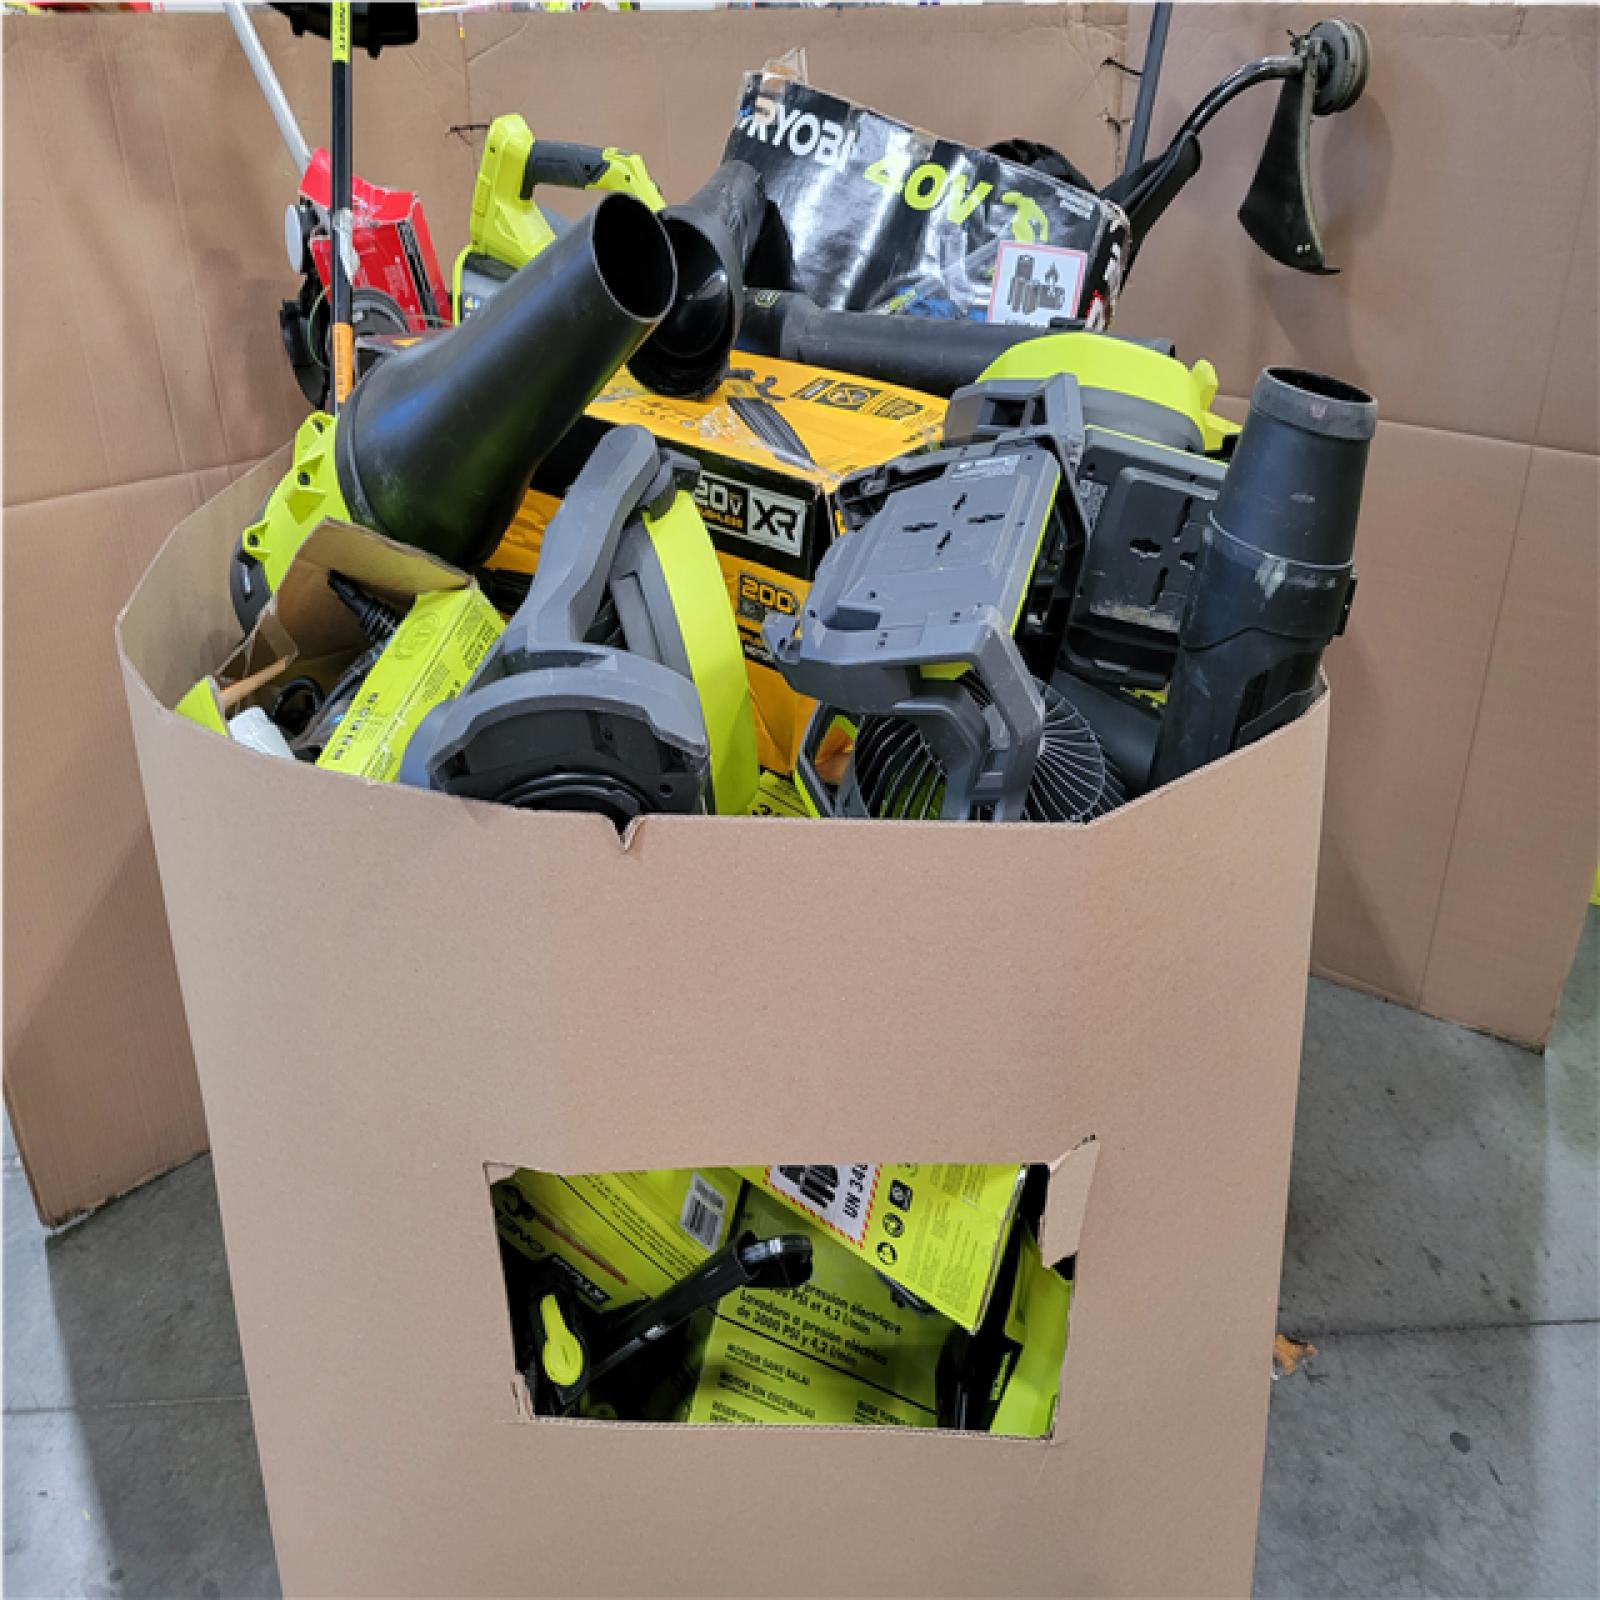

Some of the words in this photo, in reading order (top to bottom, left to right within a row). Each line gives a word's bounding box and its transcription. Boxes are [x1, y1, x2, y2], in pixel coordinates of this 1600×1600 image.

[746, 95, 857, 173] RYOBI
[864, 150, 993, 225] 40V
[751, 497, 798, 542] XR
[742, 576, 795, 614] 200
